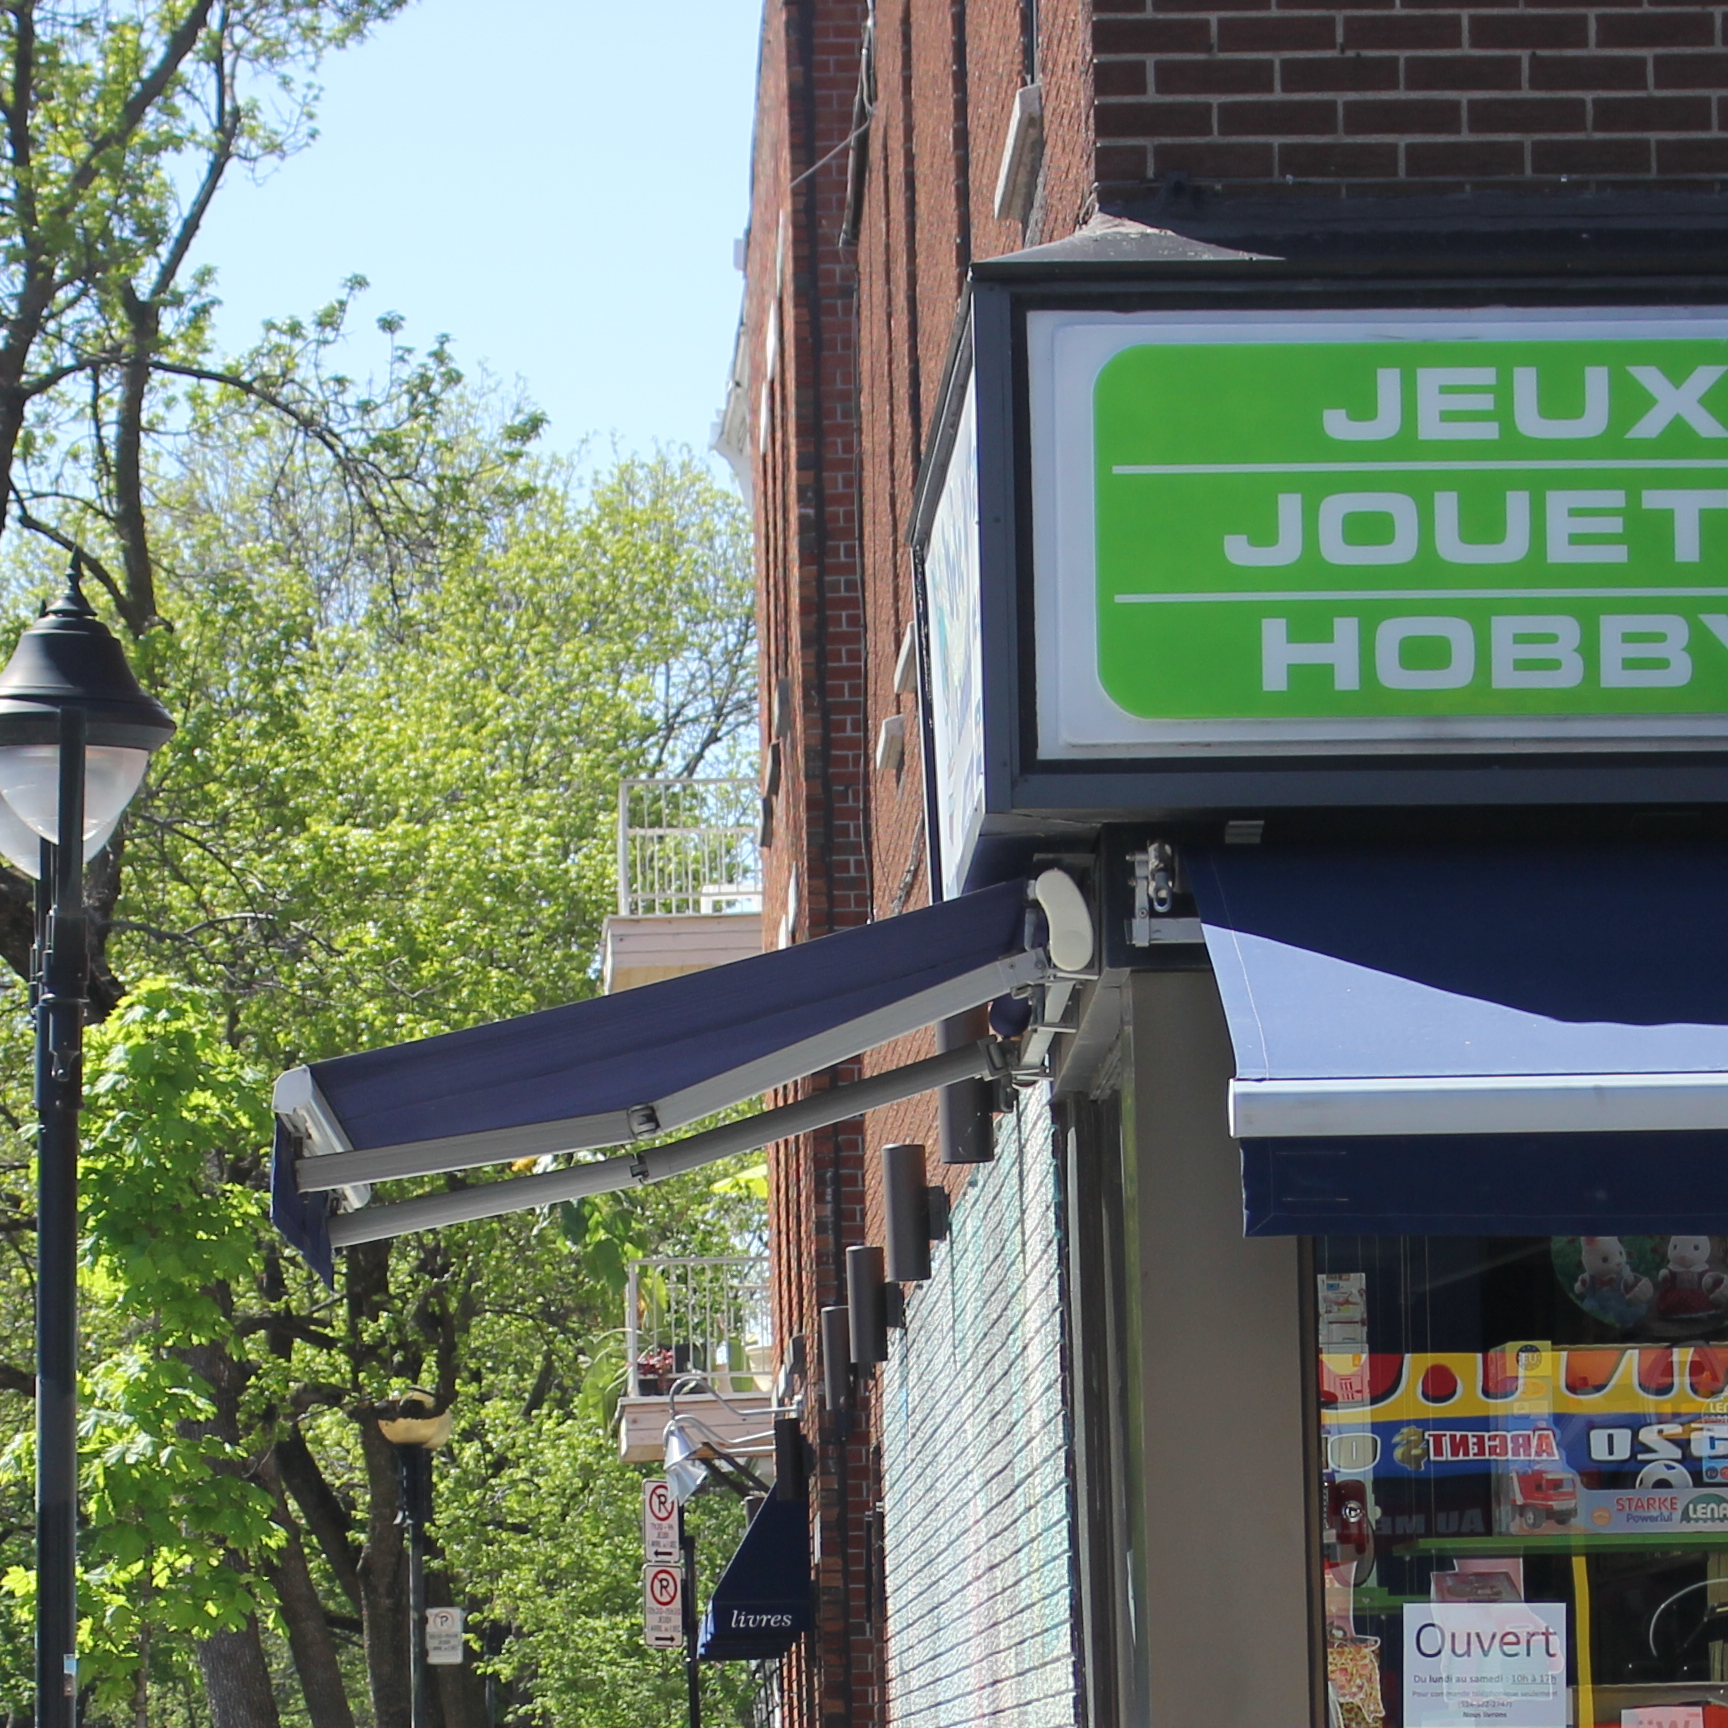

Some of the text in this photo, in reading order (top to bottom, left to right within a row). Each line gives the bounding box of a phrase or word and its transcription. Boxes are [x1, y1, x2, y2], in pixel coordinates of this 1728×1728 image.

[1615, 1496, 1678, 1512] STARKE
[1626, 1511, 1673, 1524] Powerful
[731, 1610, 792, 1628] livres
[1415, 1622, 1557, 1658] Ouvert
[1413, 1674, 1427, 1684] Du
[1428, 1673, 1453, 1684] lundi
[1455, 1676, 1467, 1684] au
[1469, 1673, 1504, 1684] samedi
[1511, 1674, 1529, 1684] 10h
[1539, 1674, 1557, 1684] 17h
